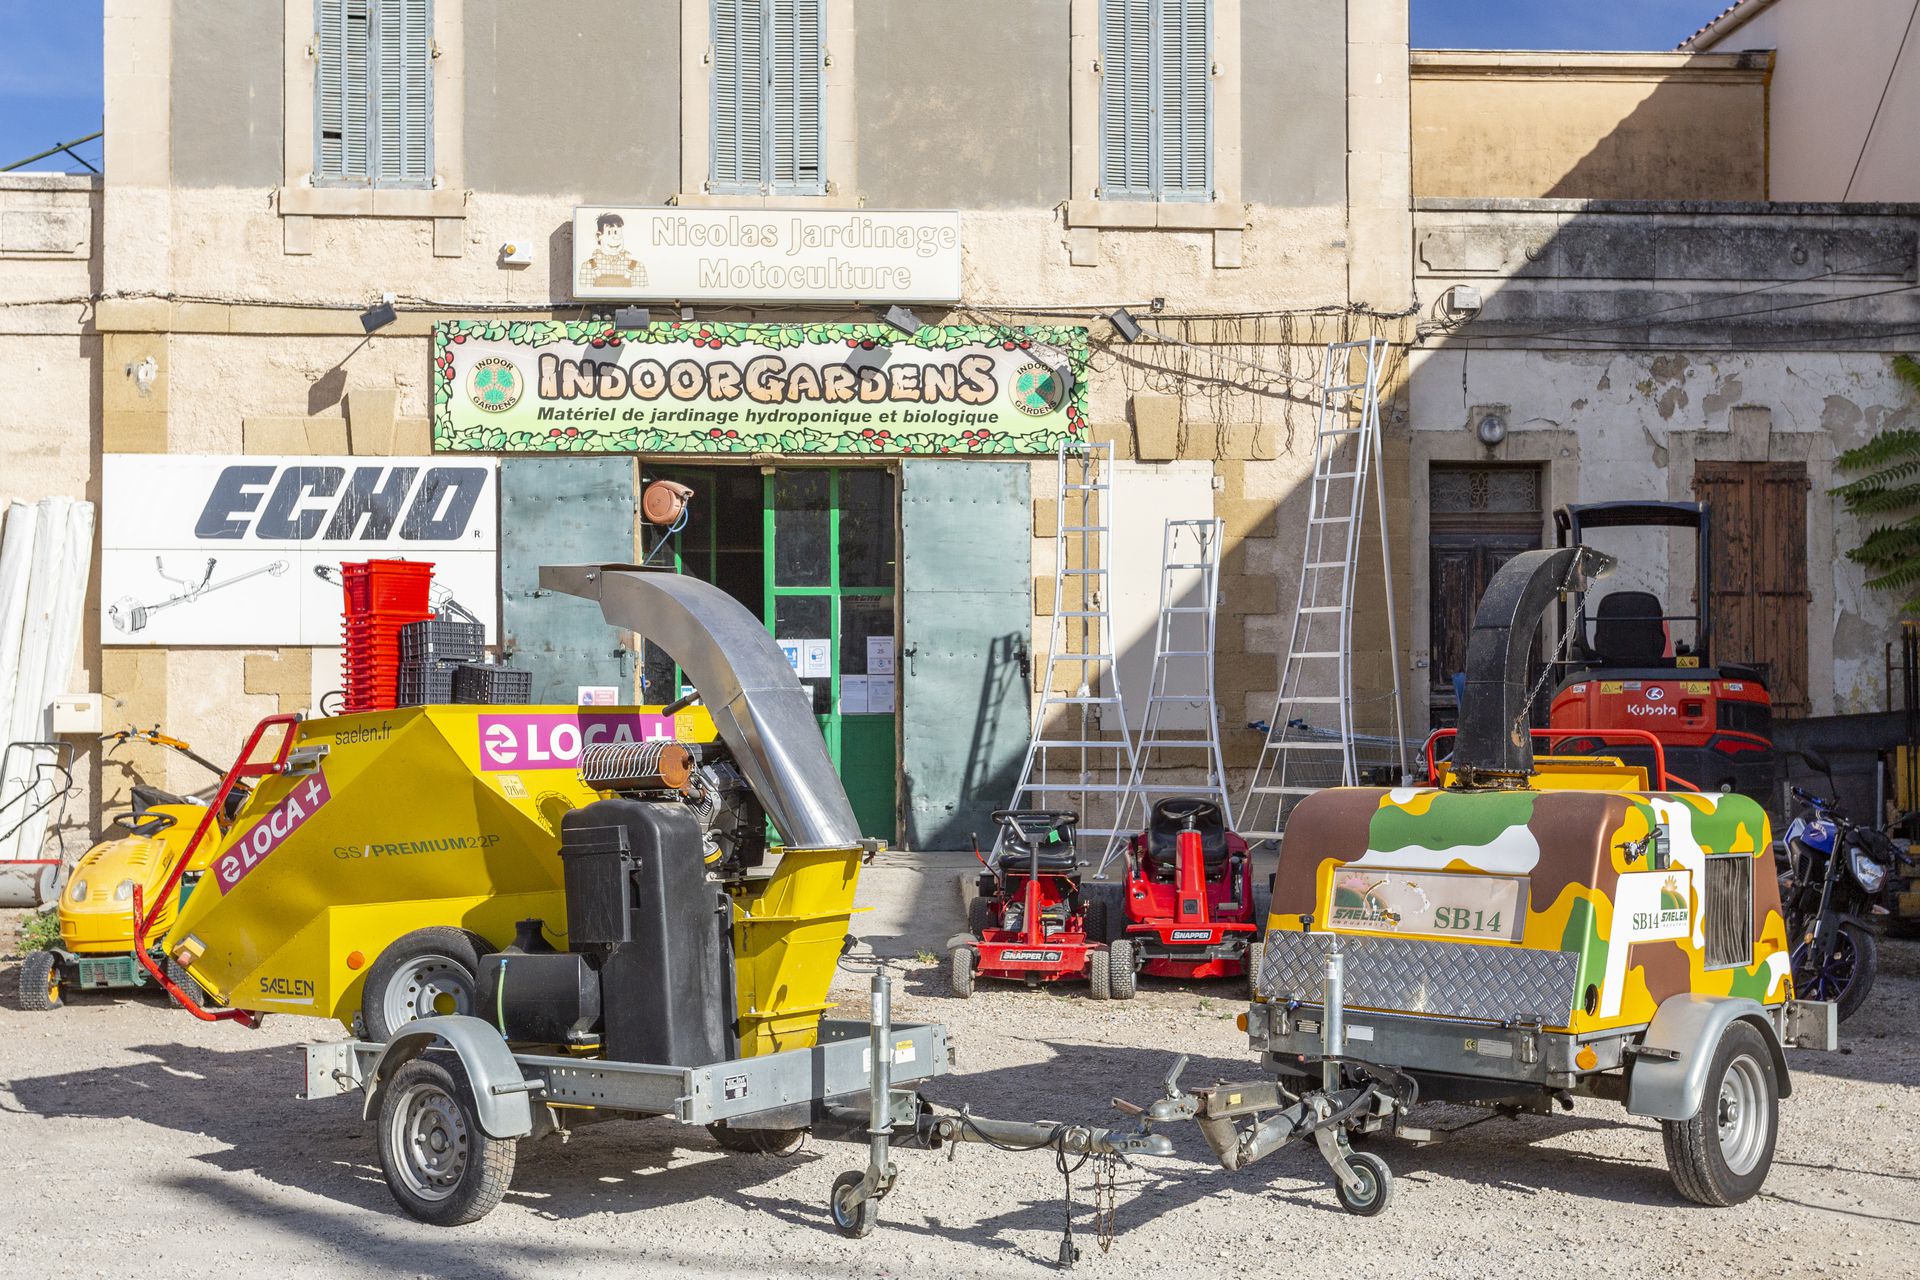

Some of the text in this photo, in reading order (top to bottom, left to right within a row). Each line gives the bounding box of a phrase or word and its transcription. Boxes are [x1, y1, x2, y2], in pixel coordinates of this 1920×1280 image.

[652, 215, 956, 257] Nicolas Jardinage
[699, 257, 912, 290] Motoculture
[475, 357, 513, 371] INDOOR
[1017, 362, 1054, 375] INDOOR
[473, 396, 516, 411] GARDENS
[1015, 400, 1057, 414] GARDENS
[537, 407, 999, 426] Matériel de jardinage hydroponique et biologique
[194, 466, 489, 541] ECHO
[1627, 703, 1677, 716] Kubota
[335, 721, 392, 746] saelen.fr
[1434, 906, 1502, 933] SB14
[1632, 912, 1659, 931] SB14
[1661, 911, 1688, 922] SAELEN
[1174, 931, 1209, 940] SNAPPER
[1002, 951, 1042, 960] SNAPPER
[260, 977, 315, 997] SAELEN
